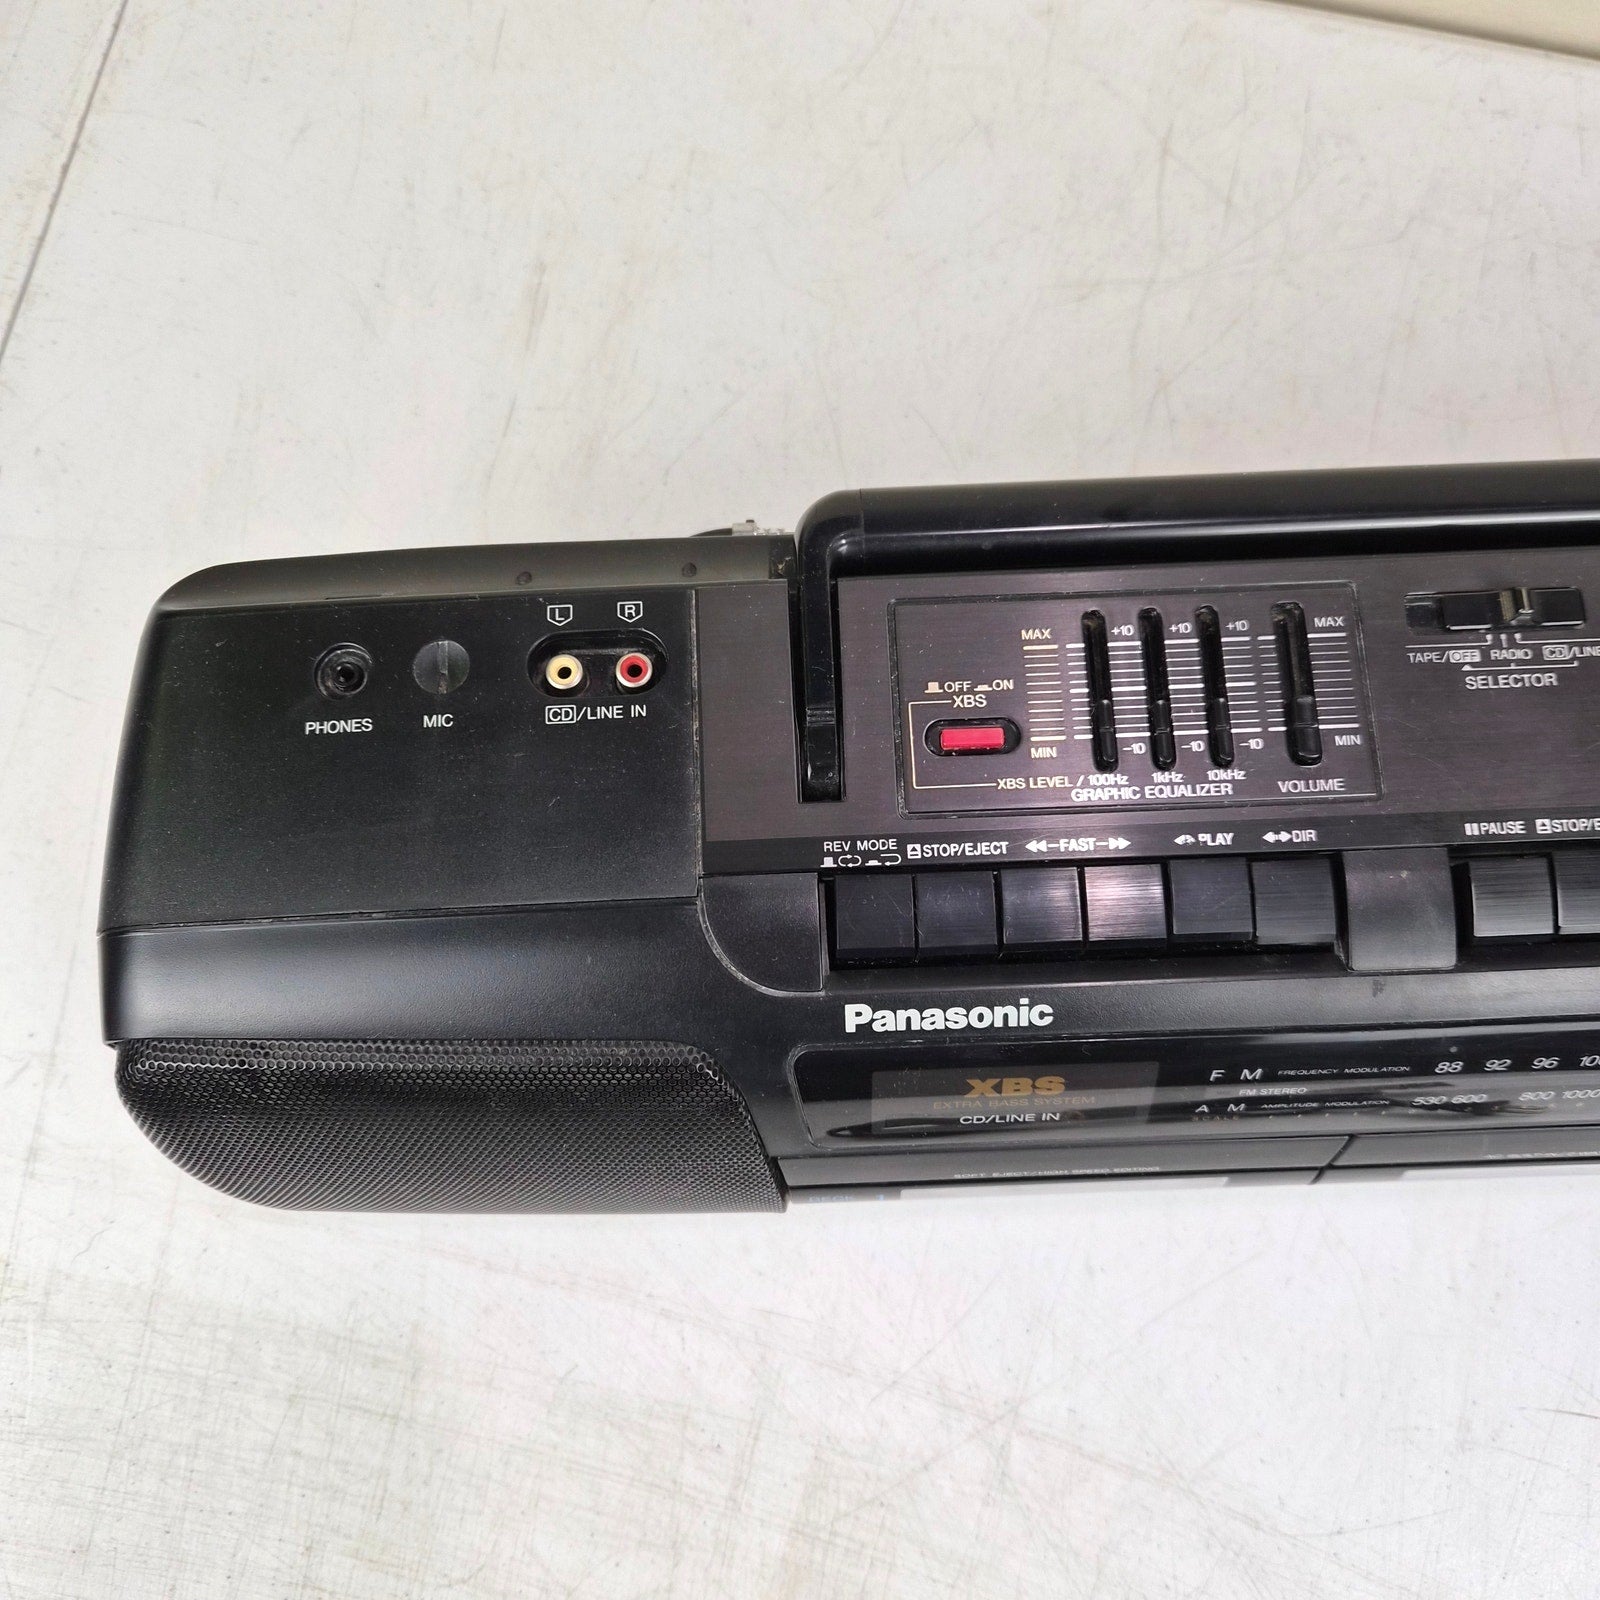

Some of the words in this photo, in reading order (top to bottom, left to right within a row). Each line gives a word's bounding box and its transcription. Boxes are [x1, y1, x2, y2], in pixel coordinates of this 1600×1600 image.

[1168, 622, 1193, 635] +10
[1225, 620, 1249, 633] +10
[1314, 616, 1345, 629] MAX
[1021, 628, 1052, 641] MAX
[1110, 623, 1134, 637] +10
[1407, 650, 1480, 664] TAPE/OFF
[1490, 648, 1533, 661] RADIO
[944, 681, 972, 693] OFF
[992, 679, 1014, 691] ON
[1464, 673, 1558, 690] SELECTOR
[953, 694, 987, 709] XBS
[545, 705, 623, 724] CD/LINE
[630, 704, 648, 719] IN
[305, 718, 374, 736] PHONES
[422, 714, 454, 729] MIC
[1334, 733, 1361, 746] MIN
[1030, 747, 1057, 759] MIN
[997, 777, 1025, 790] XBS
[1029, 775, 1073, 789] LEVEL
[1086, 773, 1130, 787] 100Hz
[1151, 771, 1184, 784] 1kHz
[1206, 769, 1247, 782] 10kHz
[1070, 785, 1141, 802] GRAPHIC
[1145, 782, 1234, 798] EQUALIZER
[1277, 778, 1346, 794] VOLUME
[1479, 820, 1527, 835] PAUSE
[1291, 829, 1318, 843] DIR
[823, 841, 851, 852] REV
[857, 839, 898, 851] MODE
[922, 841, 1009, 858] STOP/EJECT
[1059, 837, 1097, 852] FAST
[844, 998, 1055, 1034] Panasonic
[1344, 1066, 1411, 1074] MODULATION
[1434, 1061, 1465, 1074] 88
[1483, 1059, 1513, 1072] 92
[1530, 1057, 1561, 1070] 96
[1578, 1055, 1600, 1068] 10
[964, 1076, 1066, 1098] XBS
[1238, 1089, 1258, 1097] FM
[1261, 1087, 1308, 1096] STEREO
[933, 1100, 983, 1110] EXTRA
[989, 1098, 1029, 1108] BASS
[1034, 1096, 1096, 1106] SYSTEM
[1324, 1100, 1391, 1108] MODULATION
[1411, 1096, 1447, 1106] 530
[1451, 1094, 1488, 1104] 600
[1518, 1091, 1557, 1101] 800
[959, 1113, 1037, 1125] CD/LINE
[1041, 1112, 1061, 1122] IN
